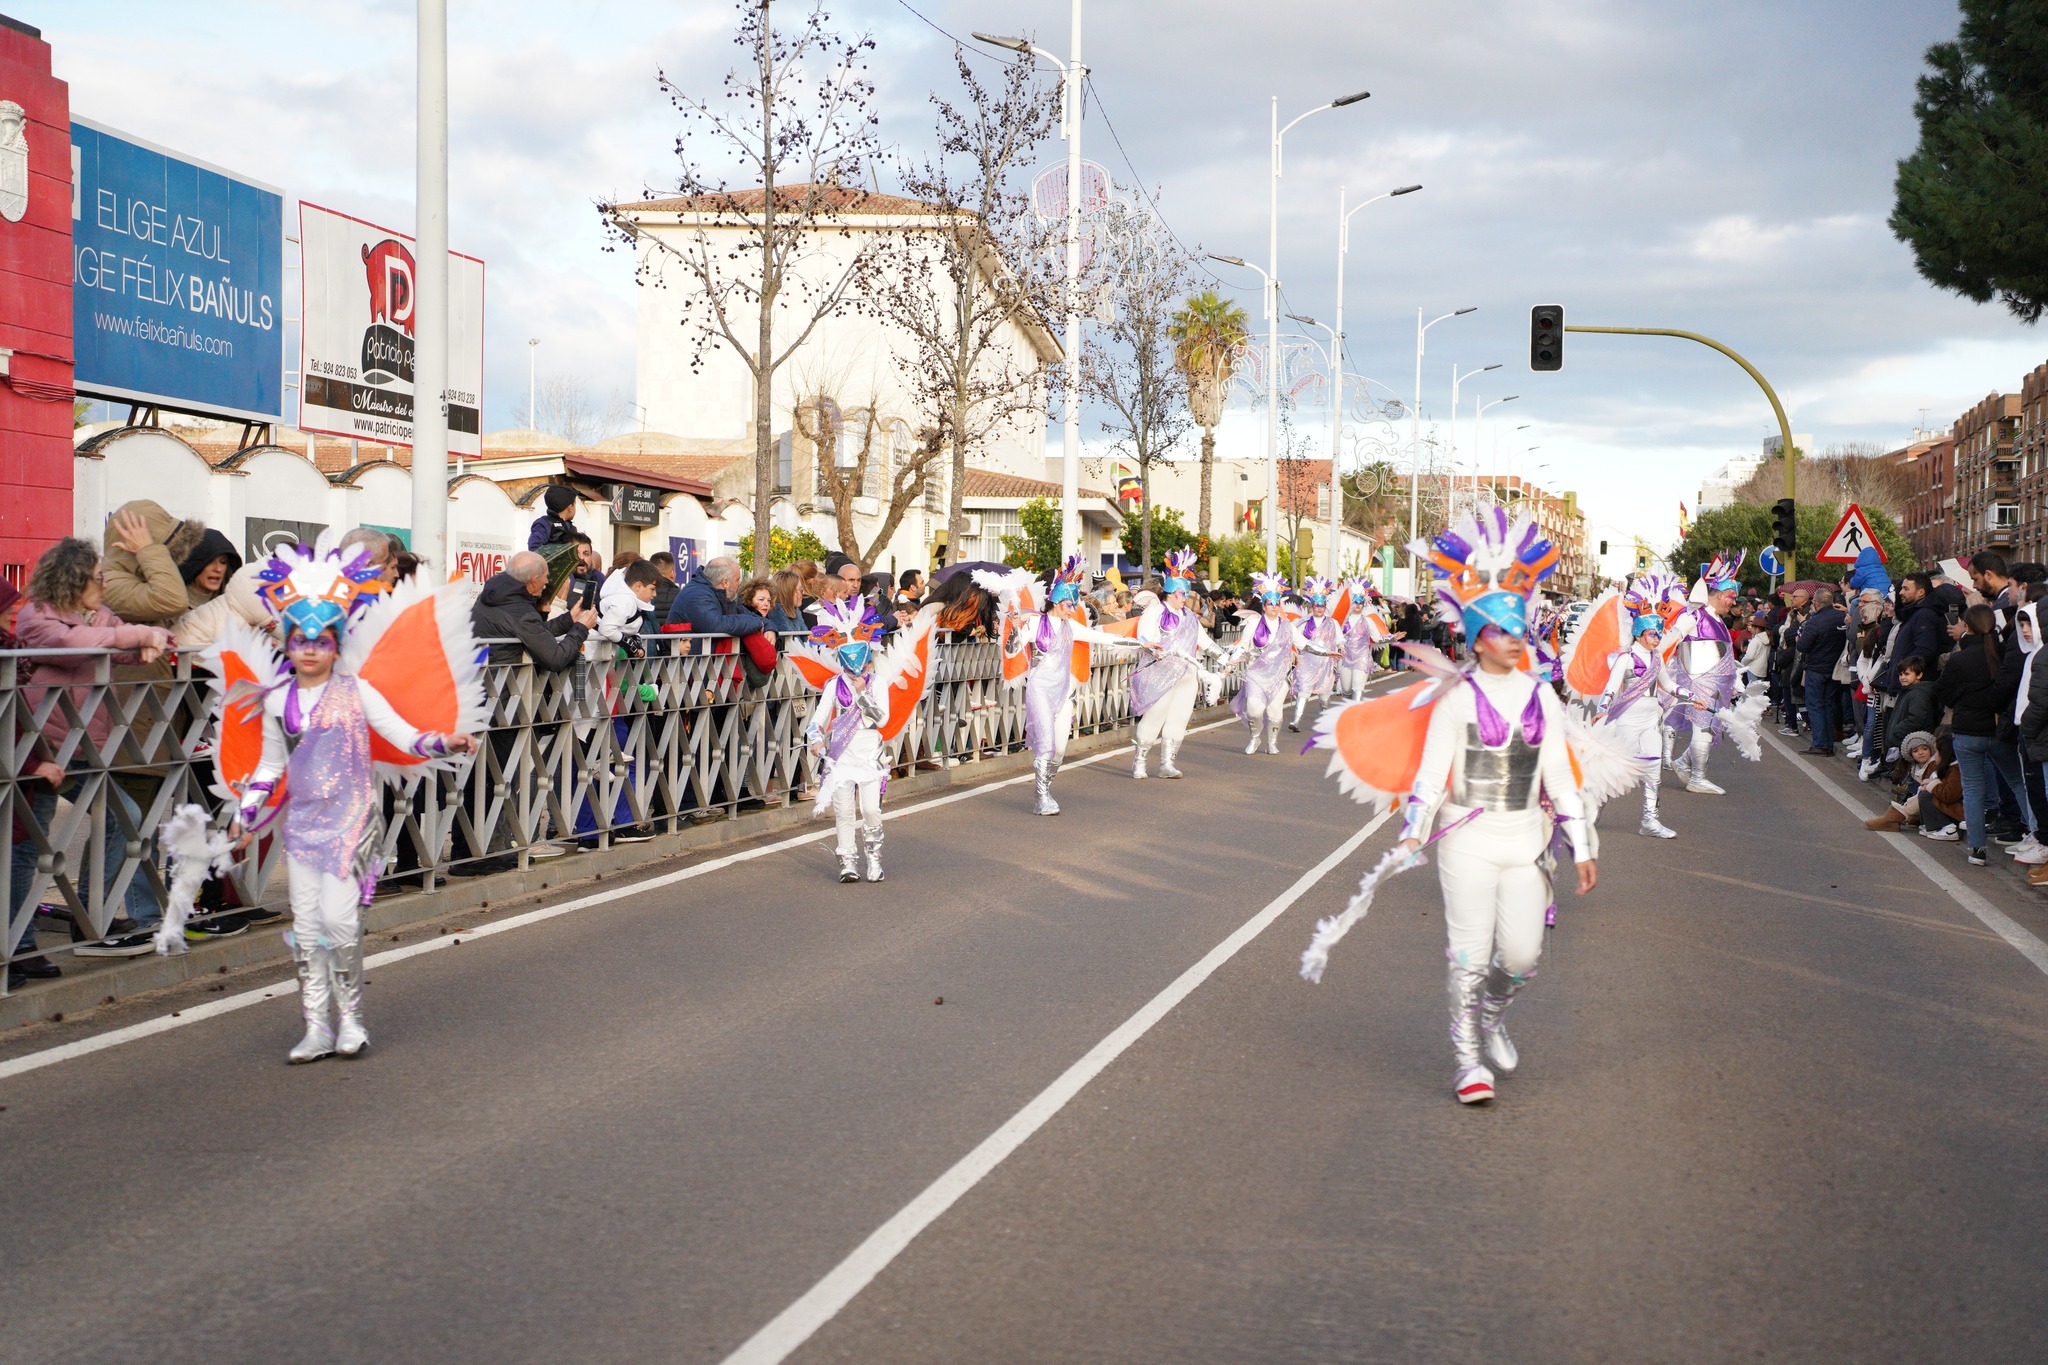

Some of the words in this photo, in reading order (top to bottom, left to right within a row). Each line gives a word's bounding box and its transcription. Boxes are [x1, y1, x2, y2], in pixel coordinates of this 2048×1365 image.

[98, 188, 167, 246] ELIGE
[171, 213, 230, 264] AZUL
[72, 244, 116, 292] IGE
[122, 254, 185, 310] FÉLIX
[190, 276, 273, 331] BAÑULS
[94, 311, 233, 358] www.felixbañuls.com
[323, 361, 334, 374] 924
[353, 388, 394, 413] Maestro
[394, 402, 408, 416] del
[353, 418, 414, 441] www.patriciope
[628, 500, 656, 514] DEPORTIVO
